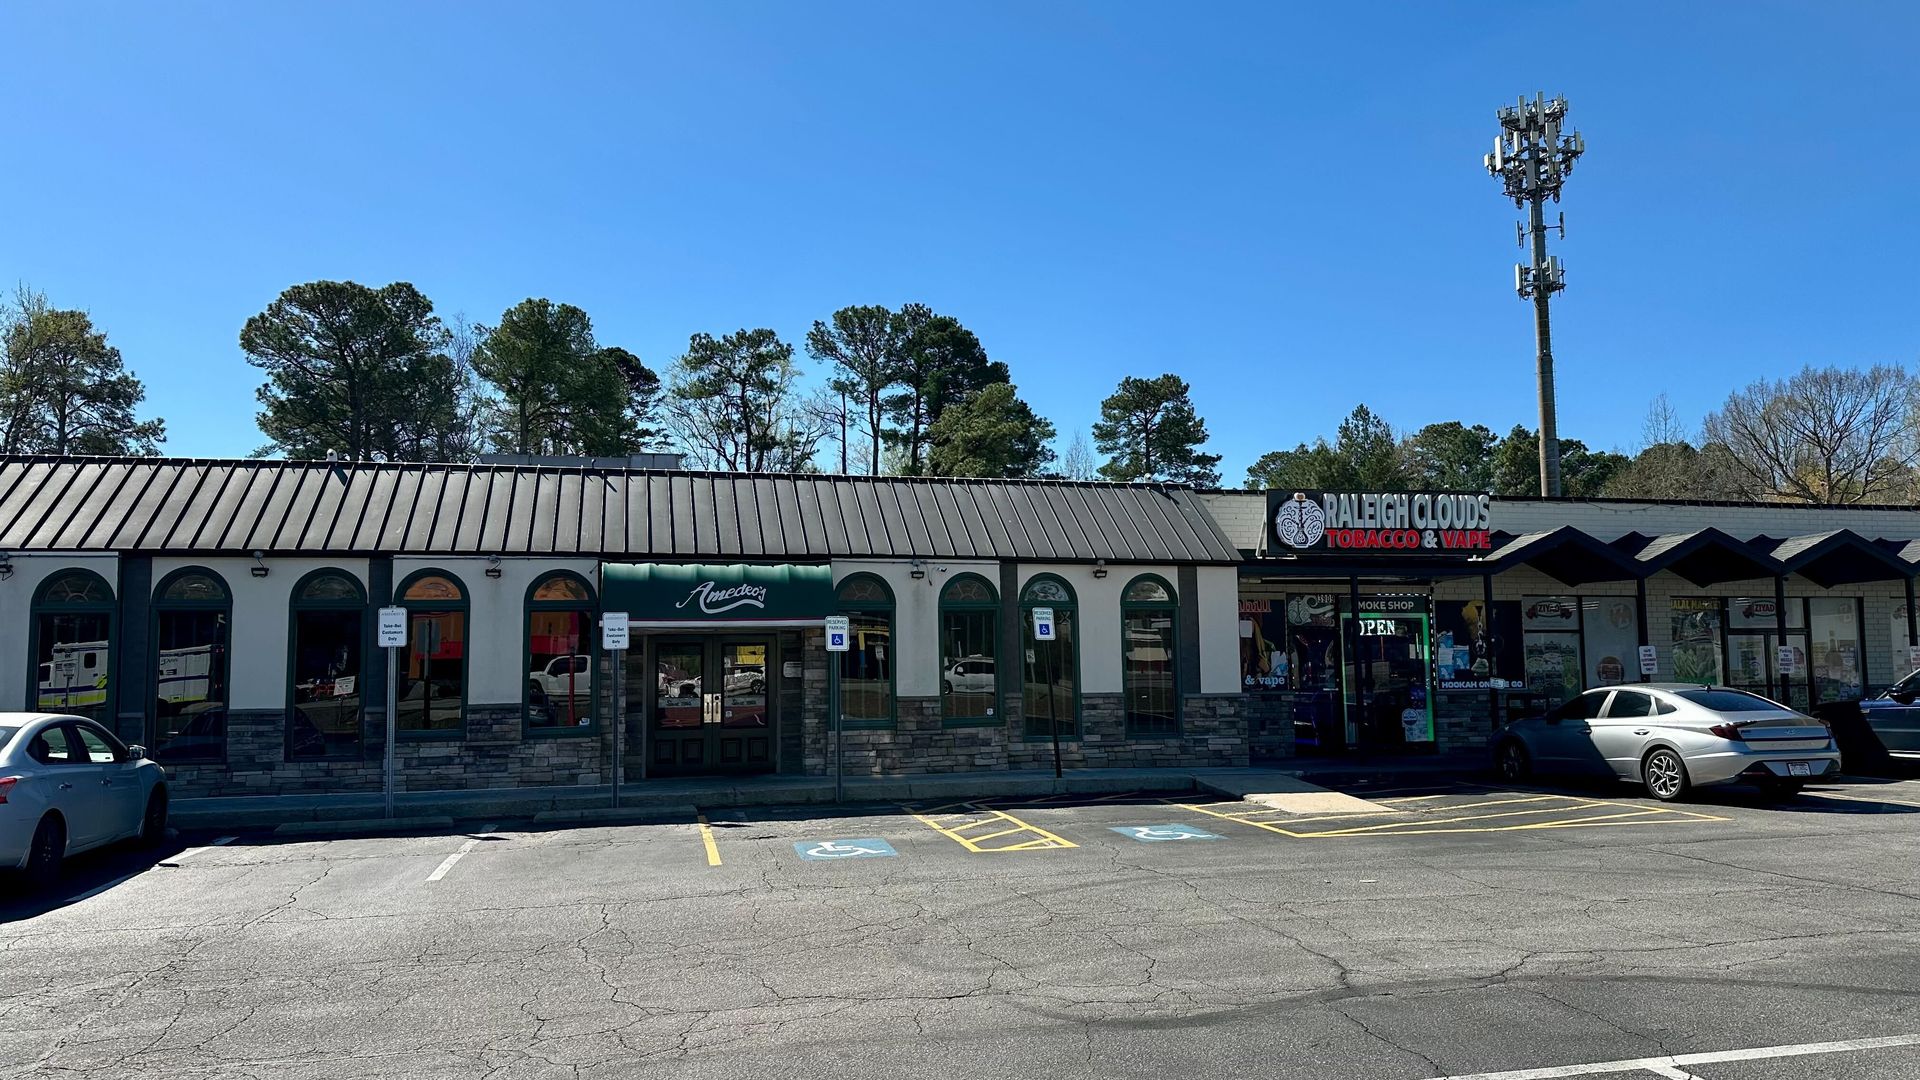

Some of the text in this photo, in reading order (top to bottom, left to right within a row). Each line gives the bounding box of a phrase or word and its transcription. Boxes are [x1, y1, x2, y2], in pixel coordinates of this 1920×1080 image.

[1322, 492, 1490, 530] RALEIGH CLOUDS
[1325, 529, 1492, 550] TOBACCO & VAPE
[675, 580, 767, 614] Amedeo's
[1358, 600, 1414, 610] MOKE SHOP
[1755, 604, 1775, 612] ZIYAD
[1244, 674, 1286, 688] & vape
[1441, 680, 1477, 689] HOOKAH
[1511, 680, 1524, 688] GO
